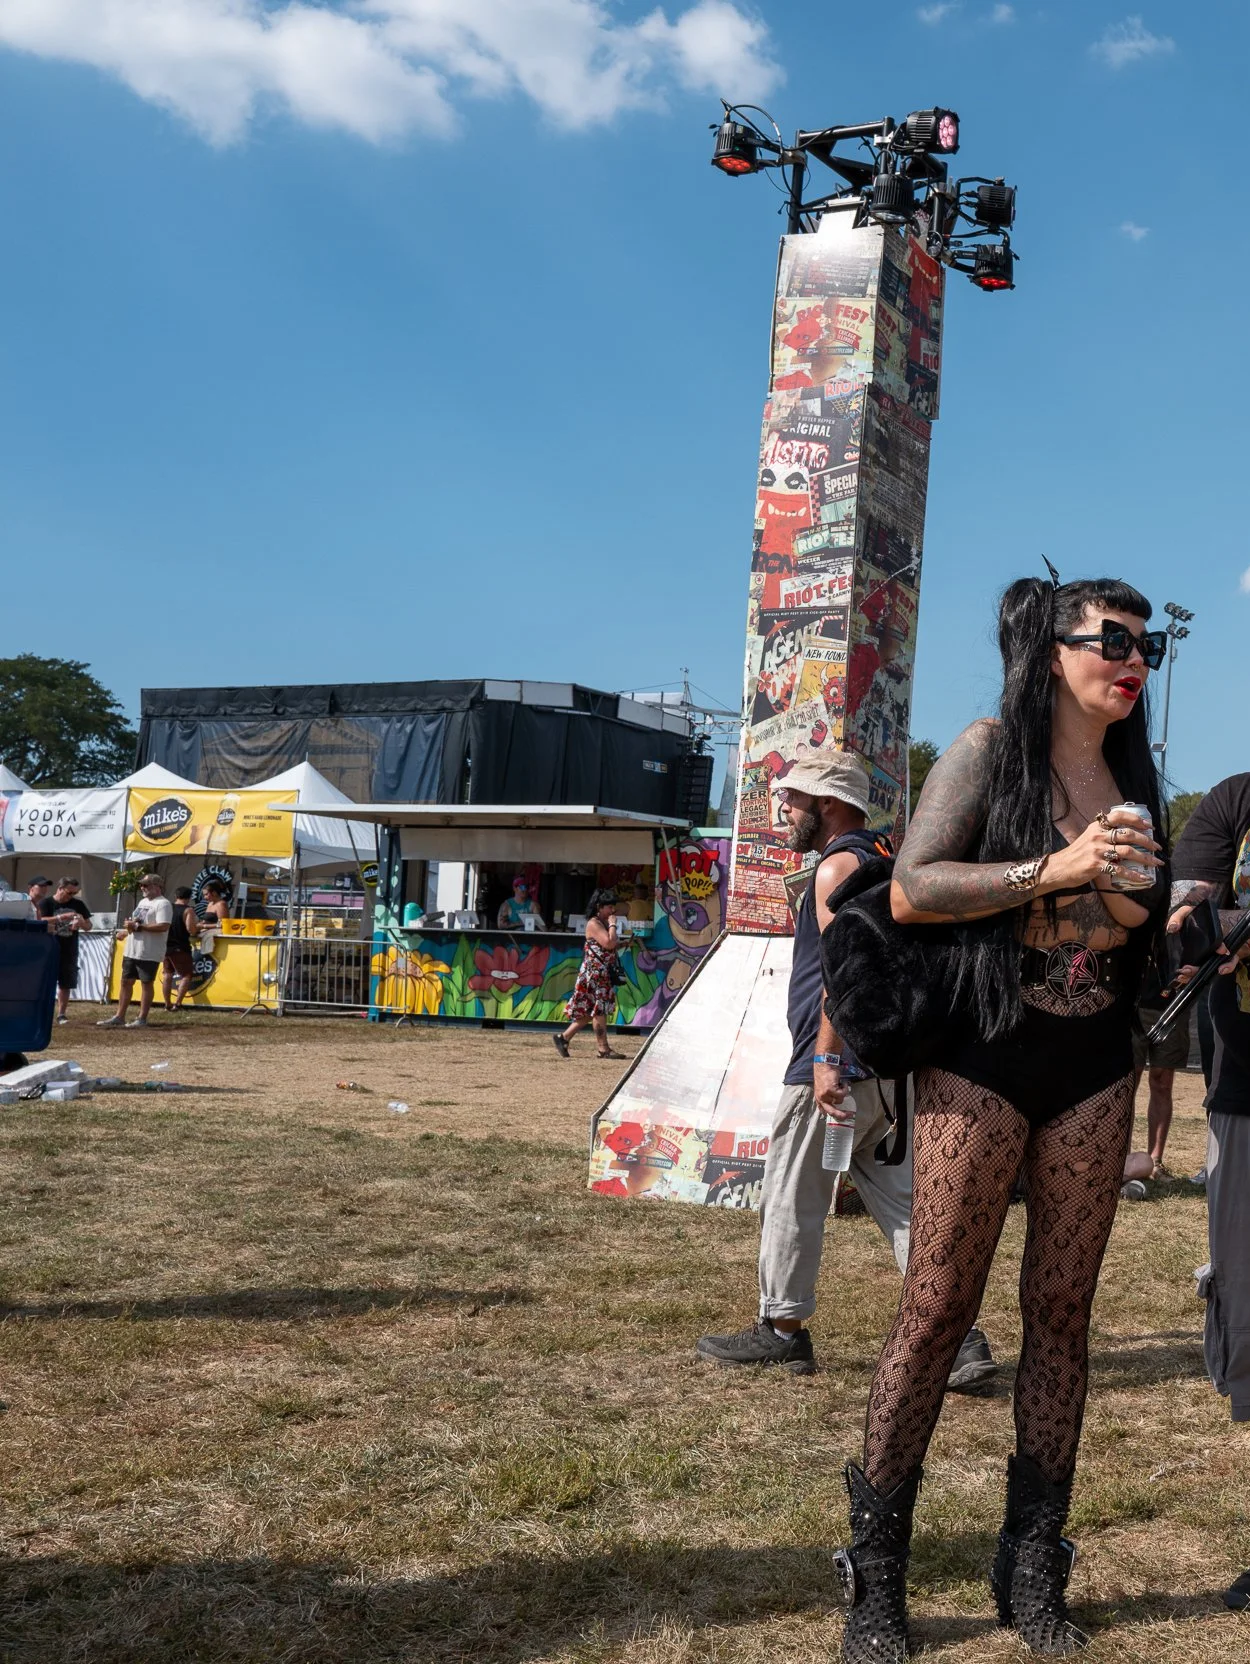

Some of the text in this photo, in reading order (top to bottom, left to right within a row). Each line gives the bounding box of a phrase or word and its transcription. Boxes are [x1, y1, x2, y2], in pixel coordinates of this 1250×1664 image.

[835, 304, 869, 324] FEST
[825, 381, 852, 398] RIO
[797, 530, 829, 554] RIOT
[784, 583, 824, 608] RIOT
[805, 649, 847, 661] NEW FOUND
[19, 808, 77, 822] VODKA
[143, 806, 188, 829] mike's
[740, 803, 768, 813] LEGACY
[754, 845, 763, 855] 15
[659, 848, 719, 883] RIOT
[191, 865, 232, 900] WHITE CLAW
[684, 877, 713, 891] POP!!
[737, 1136, 770, 1159] RIO
